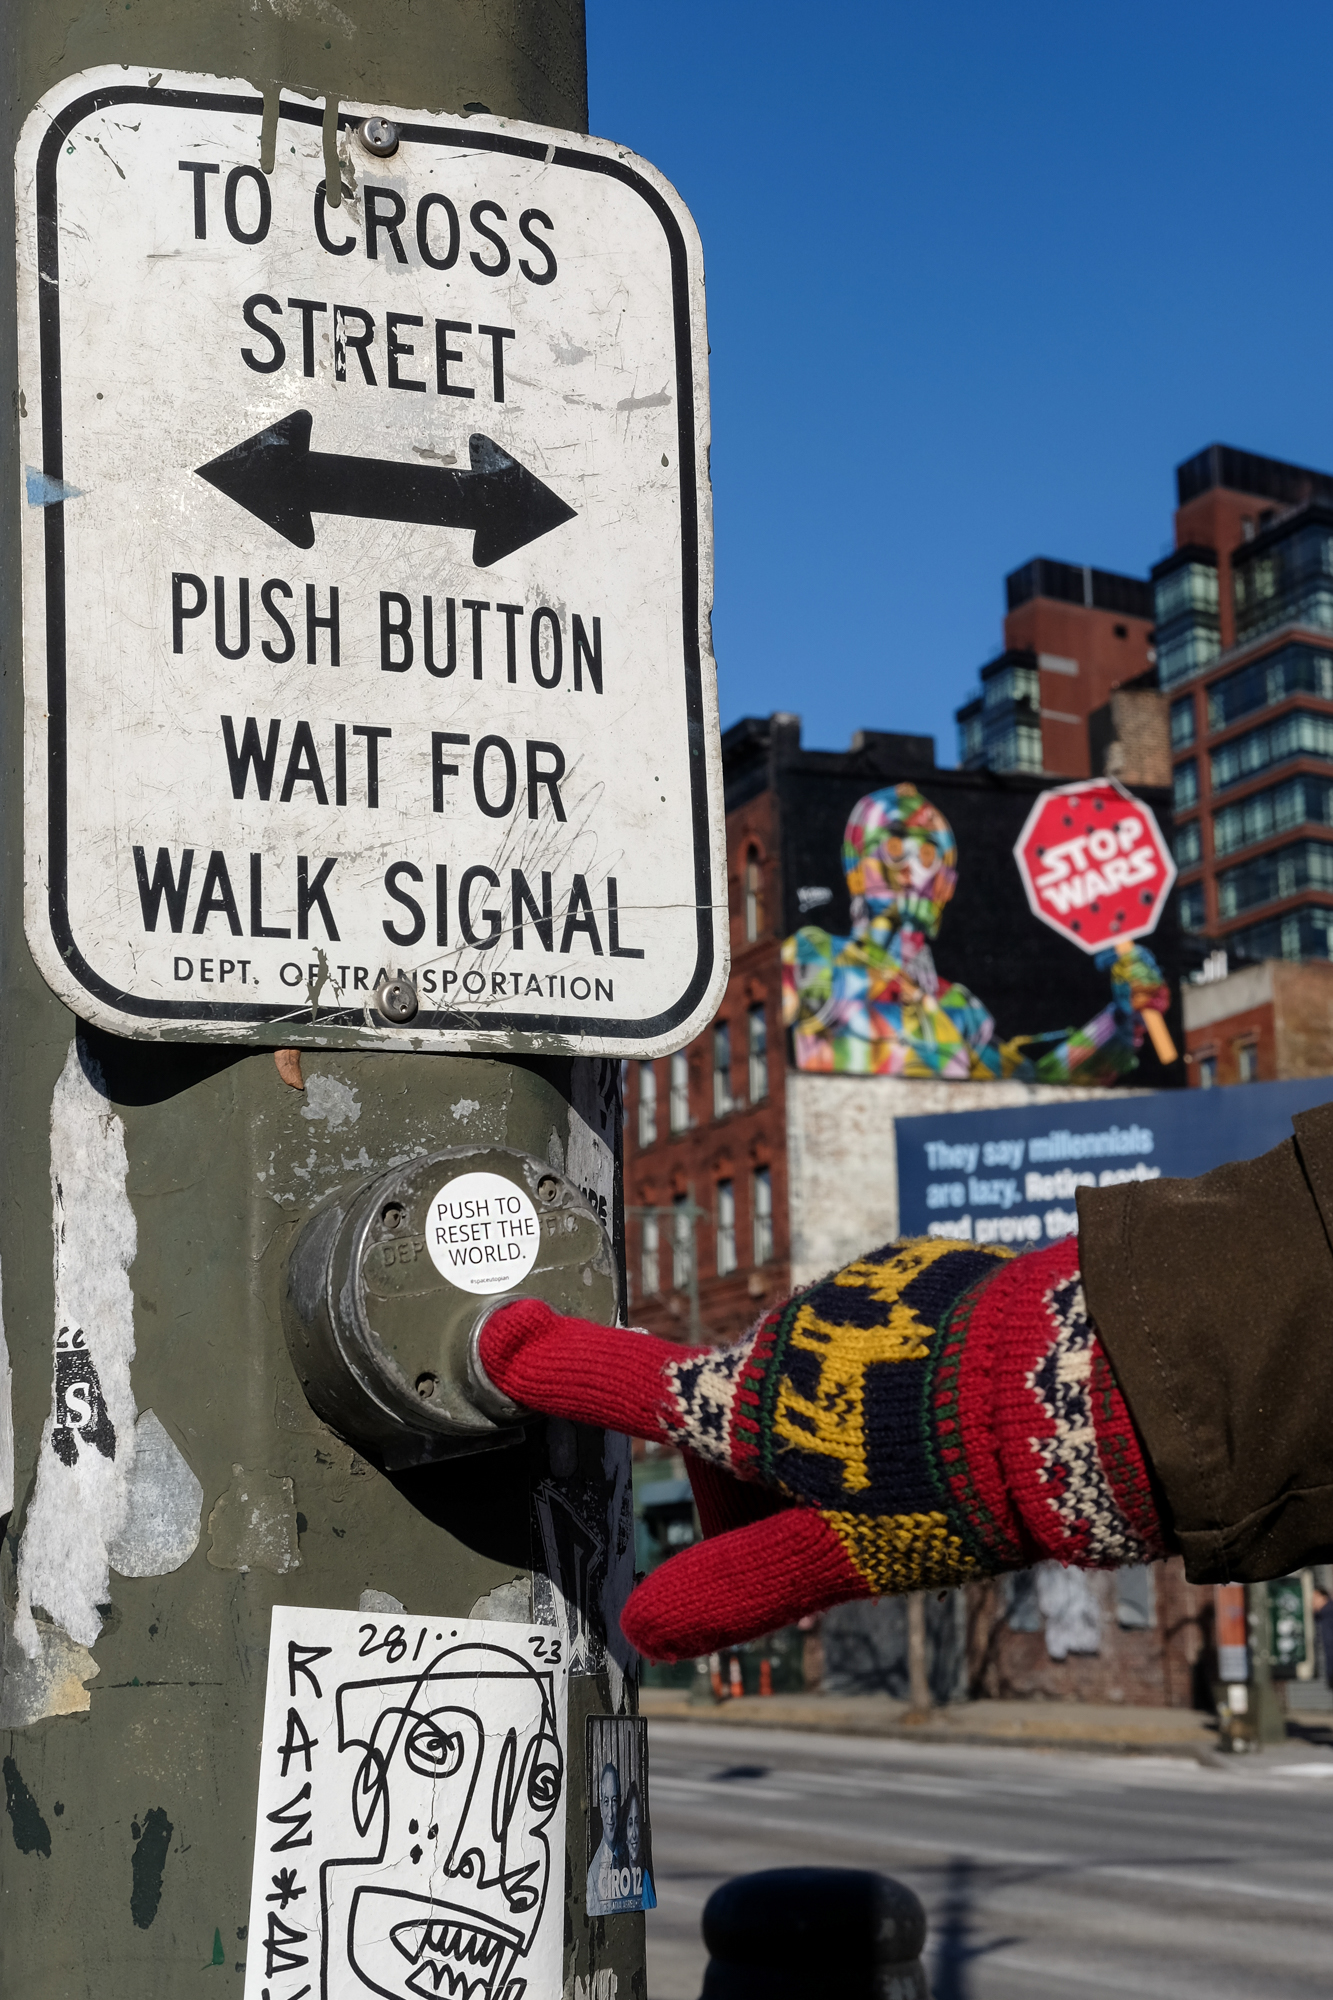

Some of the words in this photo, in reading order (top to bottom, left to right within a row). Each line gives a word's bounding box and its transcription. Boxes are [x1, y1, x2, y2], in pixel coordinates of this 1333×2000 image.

[178, 160, 272, 244] TO
[313, 180, 558, 286] CROSS
[240, 293, 516, 403] STREET
[172, 572, 341, 667] PUSH
[379, 591, 604, 695] BUTTON
[220, 715, 392, 809] WAIT
[431, 732, 568, 823] FOR
[1036, 816, 1143, 887] STOP
[1041, 845, 1157, 914] WARS
[132, 846, 341, 942] WALK
[382, 860, 646, 960] SIGNAL
[173, 956, 259, 985] DEPT.
[337, 965, 614, 1002] TRANSPORTATION
[924, 1140, 980, 1174] They
[982, 1139, 1025, 1170] say
[437, 1199, 490, 1221] PUSH
[495, 1196, 521, 1215] TO
[926, 1181, 966, 1209] are
[968, 1176, 1022, 1209] lazy.
[435, 1222, 492, 1244] RESET
[497, 1218, 535, 1238] THE
[448, 1243, 526, 1266] WORLD.
